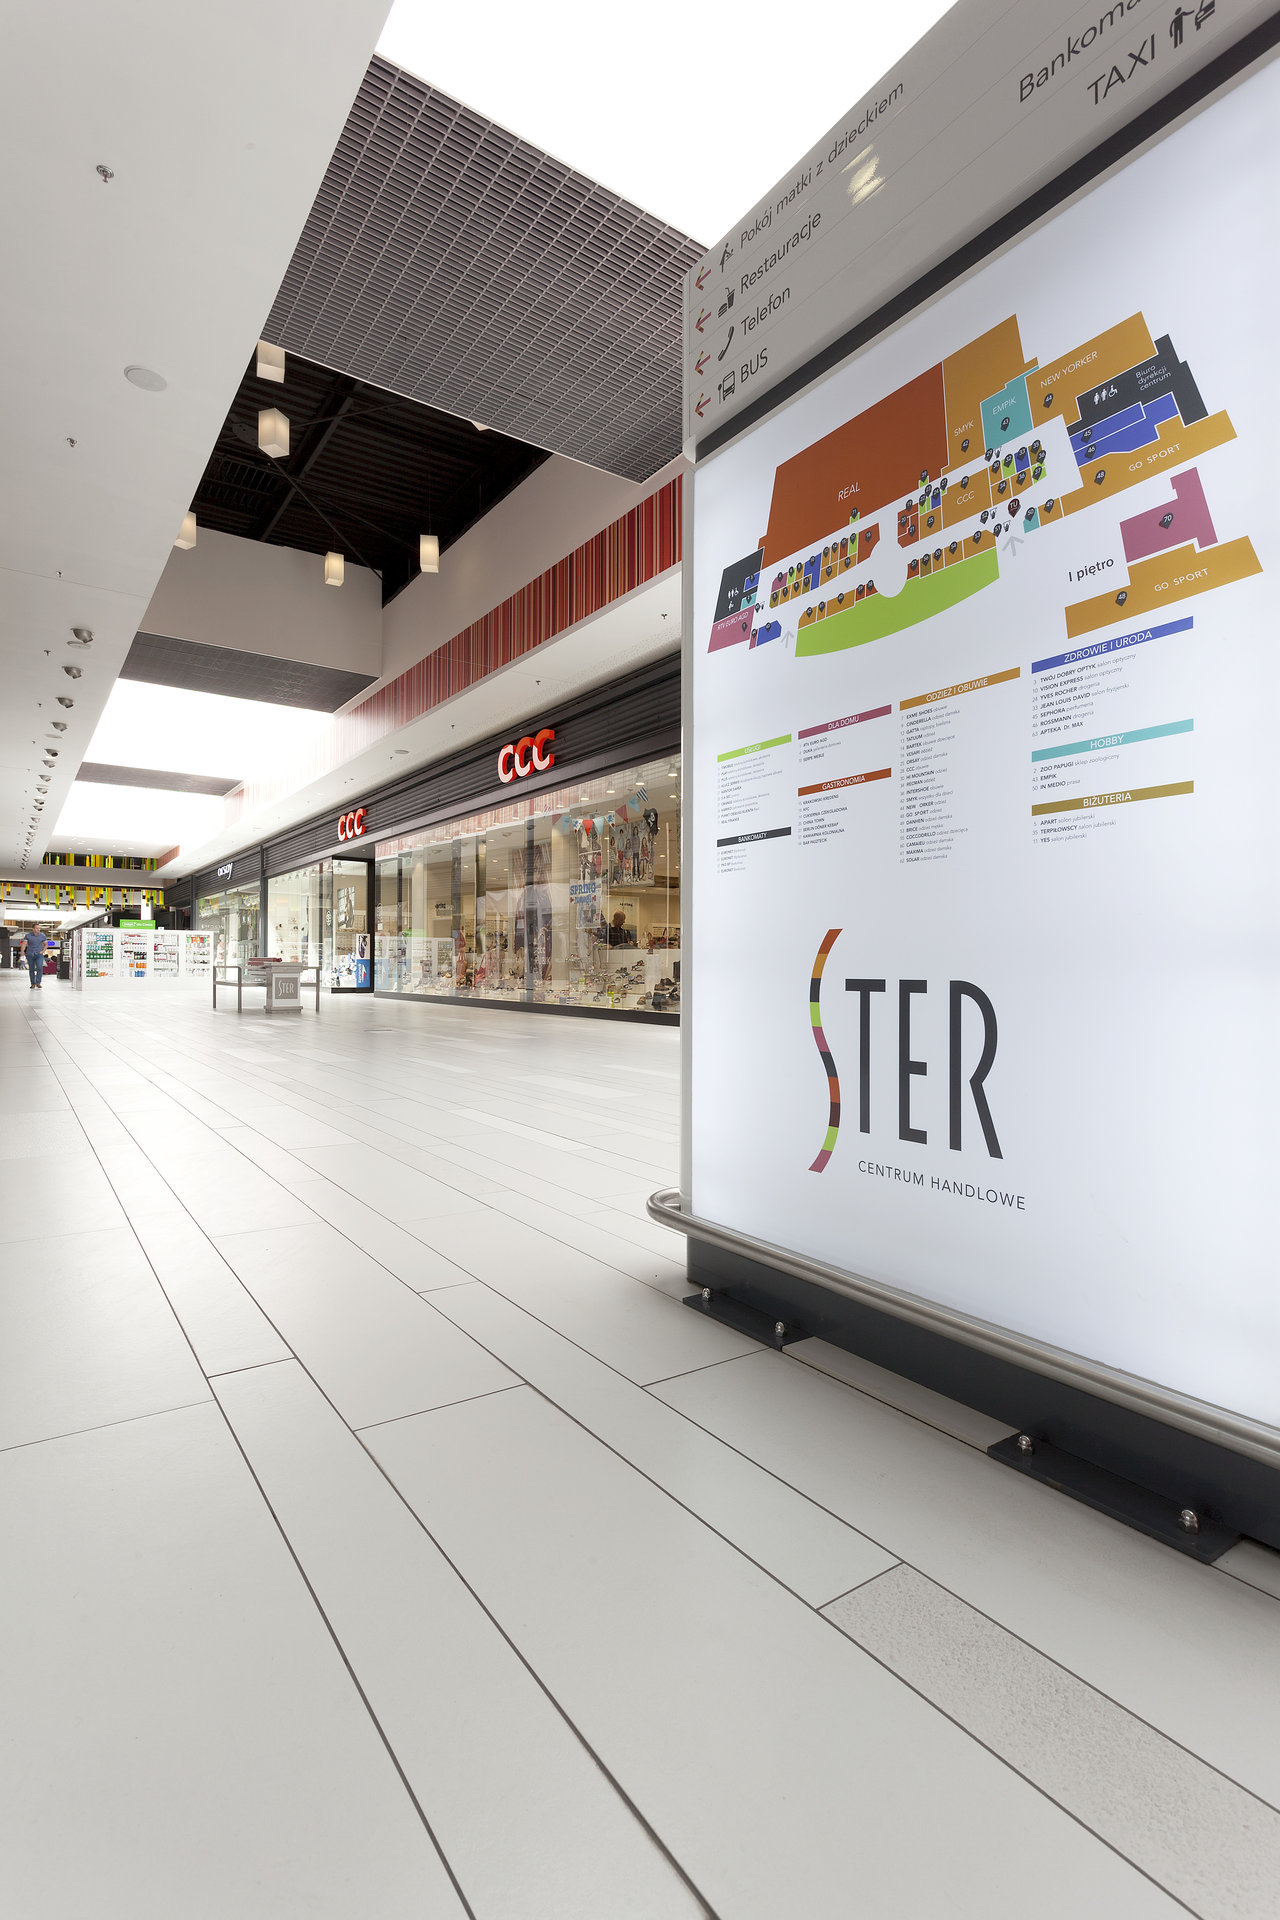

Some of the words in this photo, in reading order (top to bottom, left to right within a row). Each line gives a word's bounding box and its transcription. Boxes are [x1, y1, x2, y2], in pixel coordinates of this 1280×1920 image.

[1087, 34, 1155, 105] TAXI
[740, 210, 772, 249] Pokój
[776, 168, 812, 216] matki
[816, 160, 823, 176] z
[827, 81, 904, 164] dzieckiem
[740, 211, 822, 295] Restauracje
[741, 285, 791, 336] Telefon
[740, 347, 769, 383] BUS
[1040, 371, 1060, 388] NEW
[1062, 351, 1098, 375] YORKER
[1136, 365, 1156, 378] Biuro
[1137, 366, 1167, 385] dyrekcji
[1140, 372, 1171, 391] centrum
[992, 396, 1017, 415] EMPIK
[954, 420, 974, 437] SMYK
[1129, 461, 1142, 472] GO
[1147, 443, 1181, 464] SPORT
[838, 482, 861, 502] REAL
[956, 491, 975, 505] CCC
[1009, 501, 1018, 509] TU
[1163, 514, 1172, 522] 70
[1068, 571, 1073, 582] I
[1076, 558, 1115, 581] piętro
[1154, 581, 1169, 592] GO
[1173, 568, 1209, 586] SPORT
[1118, 592, 1126, 600] 48
[1064, 643, 1107, 663] ZDROWIE
[1116, 630, 1152, 648] URODA
[1040, 674, 1056, 683] TWÓJ
[1057, 669, 1076, 679] DOBRY
[1077, 663, 1096, 673] OPTYK
[1097, 659, 1111, 668] salon
[1112, 654, 1136, 664] optyczny
[957, 678, 989, 693] OBUWIE
[1040, 683, 1059, 692] VISION
[1060, 676, 1084, 687] EXPRESS
[1084, 672, 1099, 680] salon
[1040, 693, 1054, 701] YVES
[1055, 686, 1078, 697] ROCHER
[1040, 701, 1054, 709] JEAN
[1055, 697, 1071, 706] LOUIS
[1072, 692, 1091, 701] DAVID
[918, 708, 933, 716] SHOES
[1040, 708, 1065, 718] SEPHORA
[828, 721, 840, 730] DLA
[840, 715, 860, 727] DOMU
[906, 717, 931, 727] CINDERELLA
[1040, 715, 1072, 727] ROSSMANN
[1040, 726, 1061, 736] APTEKA
[1090, 734, 1125, 749] HOBBY
[497, 728, 556, 783] CCC
[911, 770, 934, 779] MOUNTAIN
[1040, 765, 1052, 773] ZOO
[1053, 761, 1074, 770] PAPUGI
[822, 775, 866, 790] GASTRONOMIA
[1040, 773, 1057, 781] EMPIK
[1047, 780, 1066, 788] MEDIO
[906, 786, 929, 794] INTERSHOE
[1083, 792, 1132, 807] BIŻUTERIA
[337, 807, 367, 841] CCC
[1040, 818, 1057, 826] APART
[738, 832, 768, 843] BANKOMATY
[906, 831, 936, 840] COCCODRILLO
[217, 862, 234, 880] orsay
[570, 881, 596, 896] SPRING
[278, 980, 295, 997] STER
[807, 928, 1004, 1173] STER
[858, 1159, 925, 1187] CENTRUM
[930, 1175, 1027, 1211] HANDLOWE
